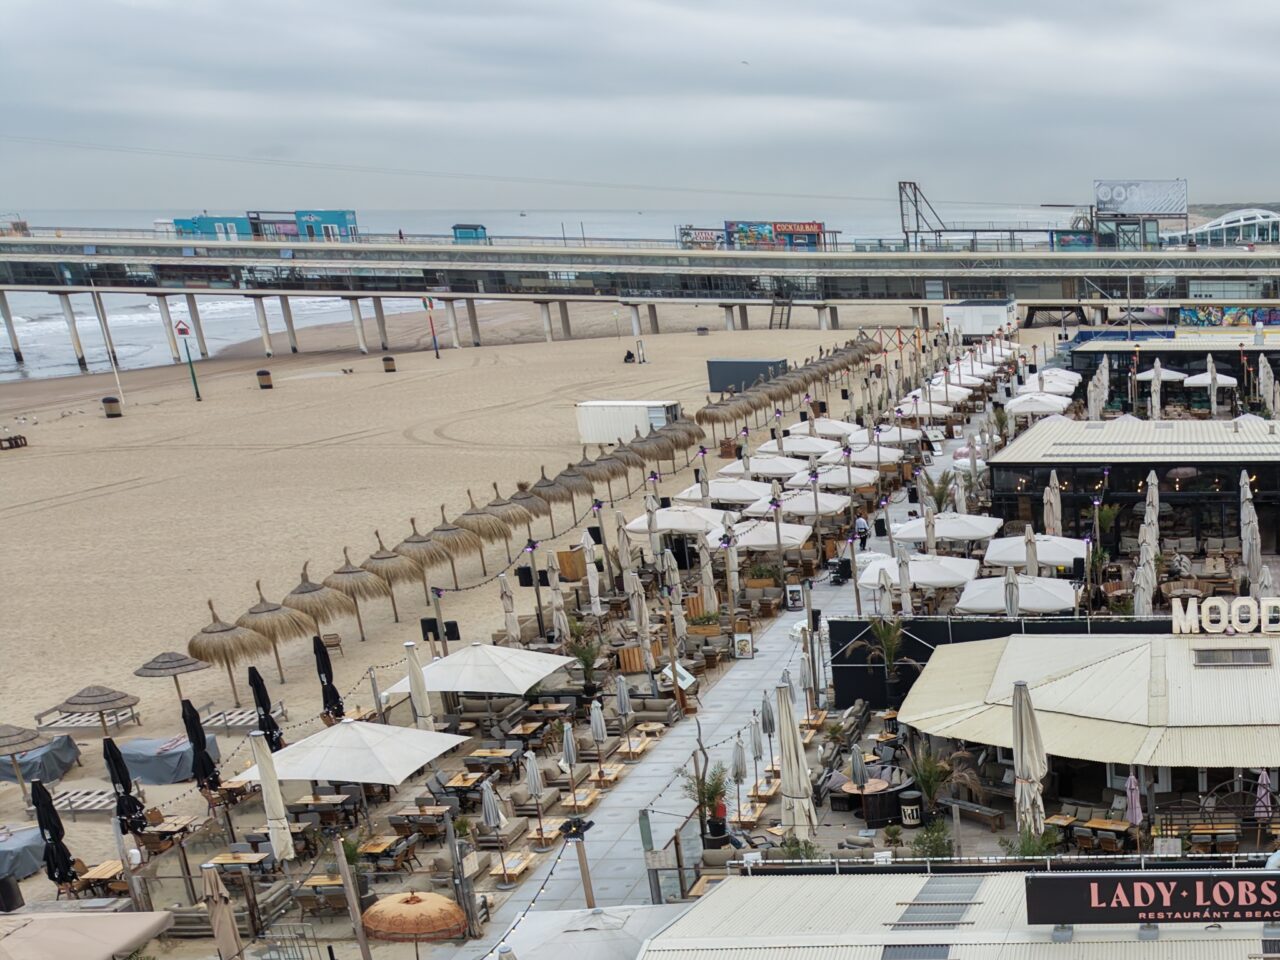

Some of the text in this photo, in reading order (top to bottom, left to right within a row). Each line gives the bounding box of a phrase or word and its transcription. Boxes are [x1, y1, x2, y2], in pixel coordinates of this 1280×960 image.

[776, 223, 805, 232] COCKTAIL
[1090, 882, 1177, 908] LADY
[1138, 911, 1230, 919] RESTAURANT
